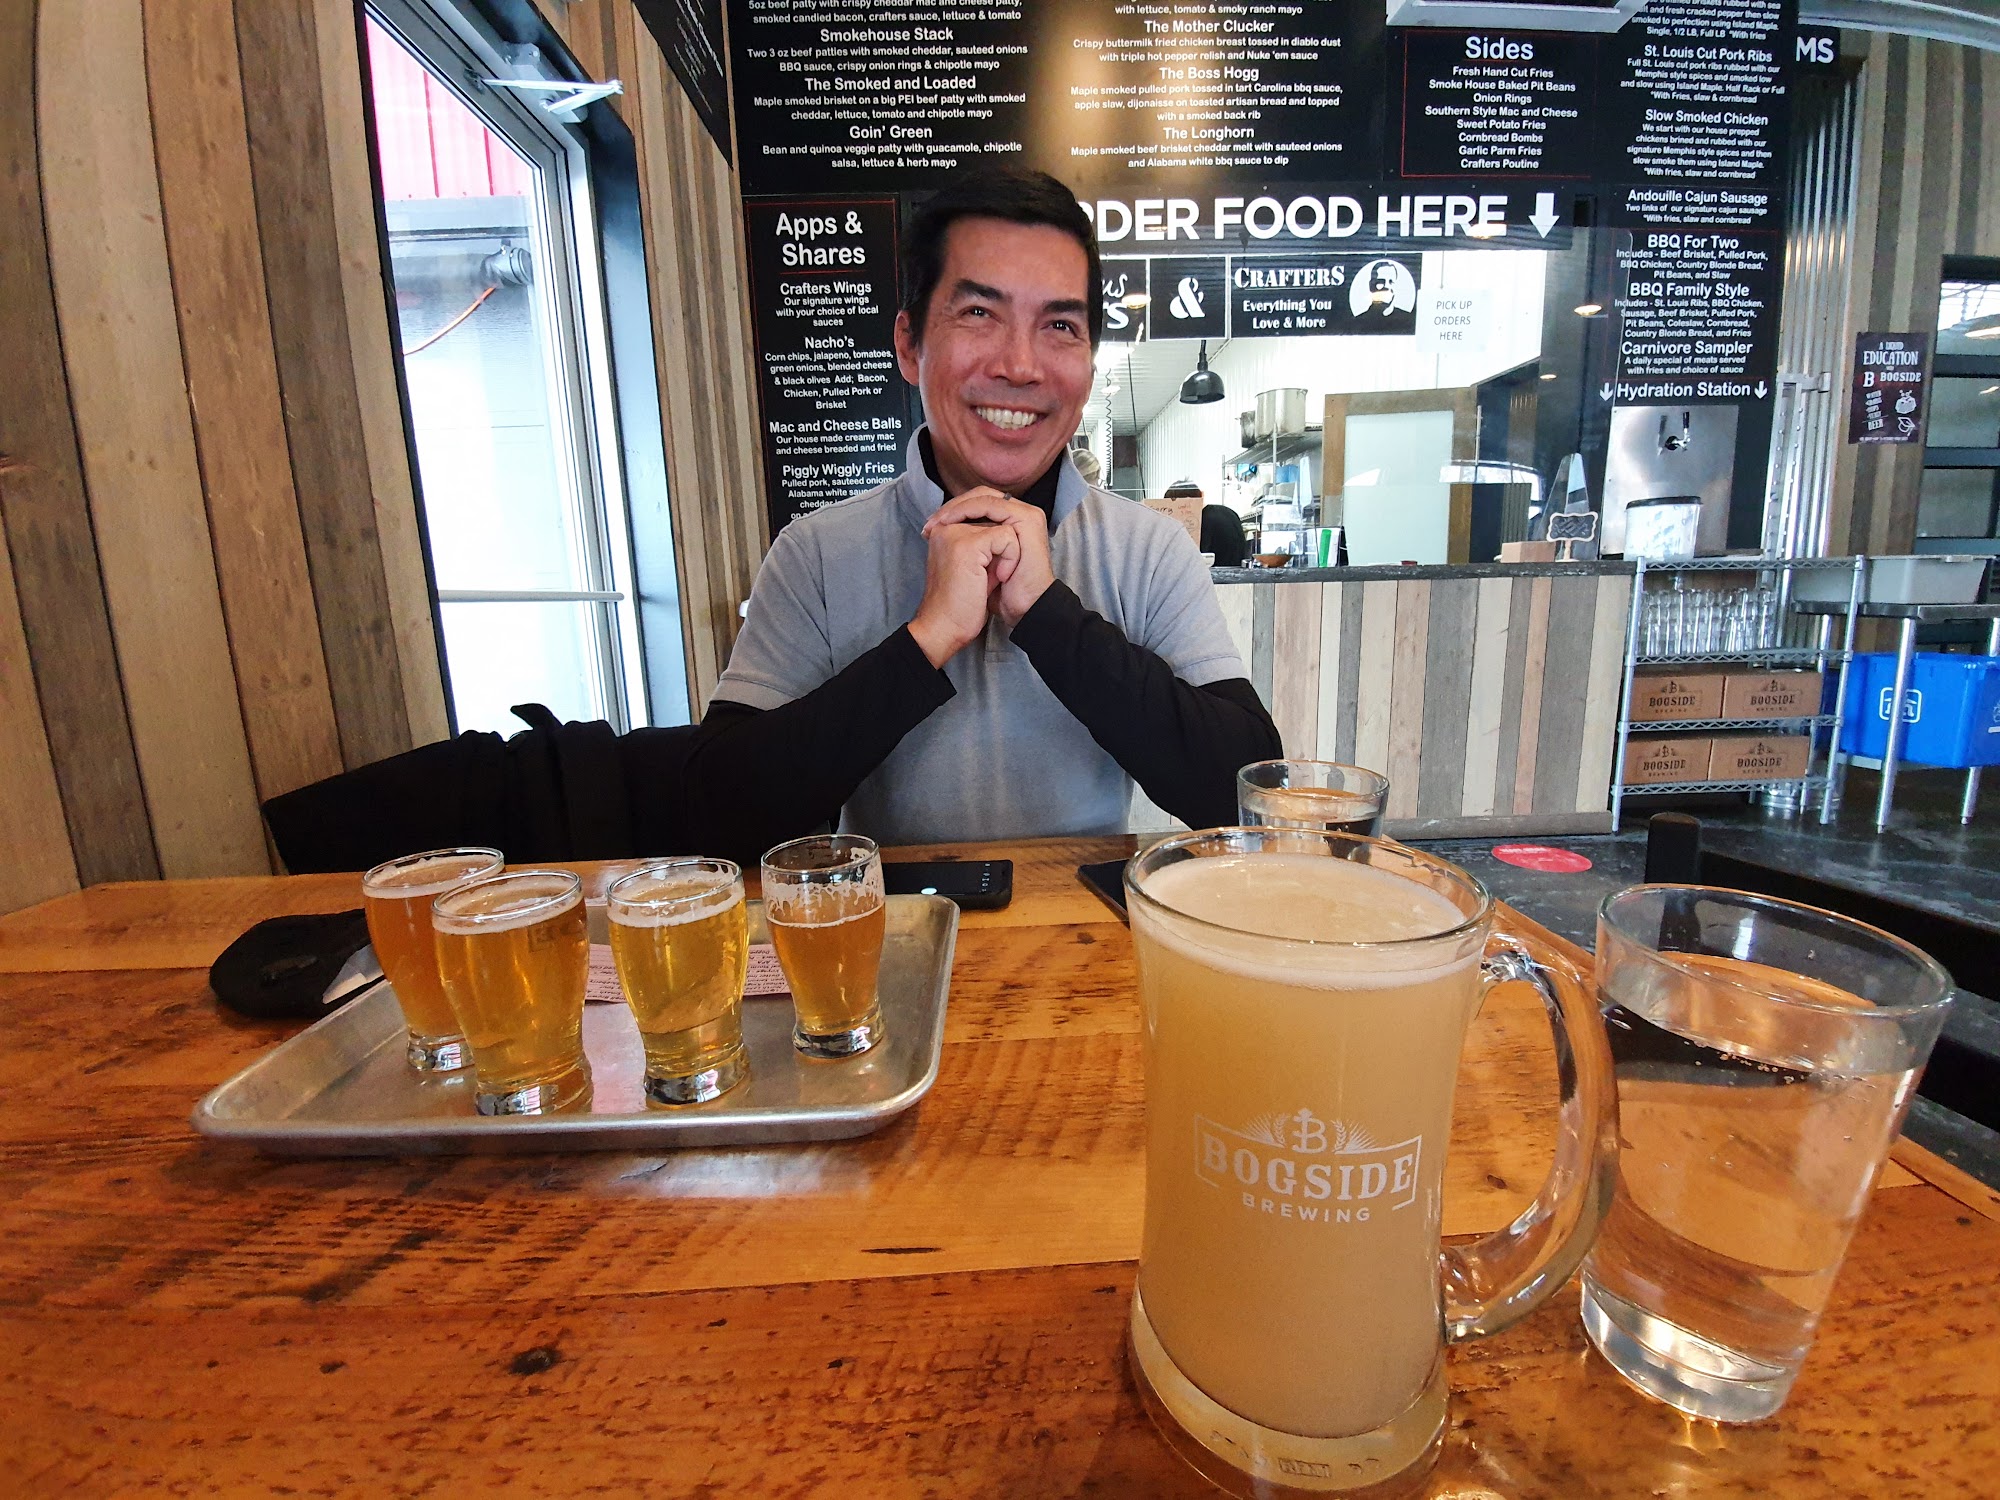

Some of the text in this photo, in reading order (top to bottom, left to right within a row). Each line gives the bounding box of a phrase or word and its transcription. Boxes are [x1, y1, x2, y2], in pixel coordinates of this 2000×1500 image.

[1114, 3, 1303, 15] with lettuce, tomato & smoky ranch mayo
[1145, 19, 1274, 33] The Mother Clucker
[820, 26, 953, 42] Smokehouse Stack
[1465, 35, 1533, 60] Sides
[1644, 44, 1772, 62] St. Louis Cut Pork Ribs
[1159, 65, 1259, 81] The Boss Hogg
[1452, 65, 1553, 78] Fresh Hand Cut Fries
[806, 75, 976, 91] The Smoked and Loaded
[1428, 78, 1575, 91] Smoke House Baked Pit Beans
[1473, 92, 1532, 105] Onion Rings
[1424, 105, 1577, 118] Southern Style Mac and Cheese
[1645, 108, 1768, 125] Slow Smoked Chicken
[1456, 118, 1546, 129] Sweet Potato Fries
[889, 124, 932, 138] Green
[1163, 125, 1254, 141] The Longhorn
[1458, 131, 1543, 142] Cornbread Bombs
[1458, 145, 1542, 155] Garlic Parm Fries
[831, 156, 957, 169] salsa, lettuce & herb mayo
[1460, 158, 1539, 168] Crafters Poutine
[1627, 189, 1767, 206] Andouille Cajun Sausage
[775, 210, 862, 239] Apps &
[1078, 196, 1507, 241] DER FOOD HERE
[1647, 233, 1739, 249] BBQ For Two
[782, 242, 865, 265] Shares
[1234, 265, 1345, 288] CRAFTERS
[780, 280, 871, 295] Crafters Wings
[1630, 282, 1749, 299] BBQ Family Style
[783, 295, 869, 307] Our signature wings
[1169, 277, 1205, 318] &
[1436, 300, 1472, 309] PICK UP
[775, 304, 878, 318] with your choice of local
[1242, 298, 1331, 313] Everything You
[812, 318, 843, 326] sauces
[1252, 315, 1326, 329] Love & More
[1433, 315, 1470, 325] ORDERS
[1439, 331, 1462, 340] HERE
[764, 348, 894, 362] Corn chips, jalapeno, tomatoes,
[1621, 340, 1753, 356] Carnivore Sampler
[1863, 351, 1919, 365] EDUCATION
[769, 360, 892, 374] green onions, blended cheese
[774, 376, 781, 385] &
[782, 375, 805, 385] black
[806, 375, 830, 384] olives
[857, 373, 888, 383] Bacon,
[1880, 372, 1921, 382] BOGSIDE
[783, 388, 821, 398] Chicken,
[822, 386, 850, 396] Pulled
[851, 386, 871, 395] Pork
[1617, 381, 1750, 400] Hydration Station
[815, 400, 846, 409] Brisket
[769, 416, 901, 433] Mac and Cheese Balls
[775, 435, 792, 444] Our
[793, 435, 818, 443] house
[819, 433, 843, 442] made
[844, 433, 875, 442] creamy
[775, 442, 896, 454] and cheese breaded and fried
[782, 461, 894, 479] Piggly Wiggly Fries
[1649, 696, 1696, 707] BOGSIDE
[1750, 694, 1795, 705] BOGSIDE
[1643, 759, 1686, 771] BOGSIDE
[1737, 757, 1783, 768] BOGSIDE
[1203, 1134, 1415, 1200] BOGSIDE
[1242, 1192, 1370, 1223] BREWING
